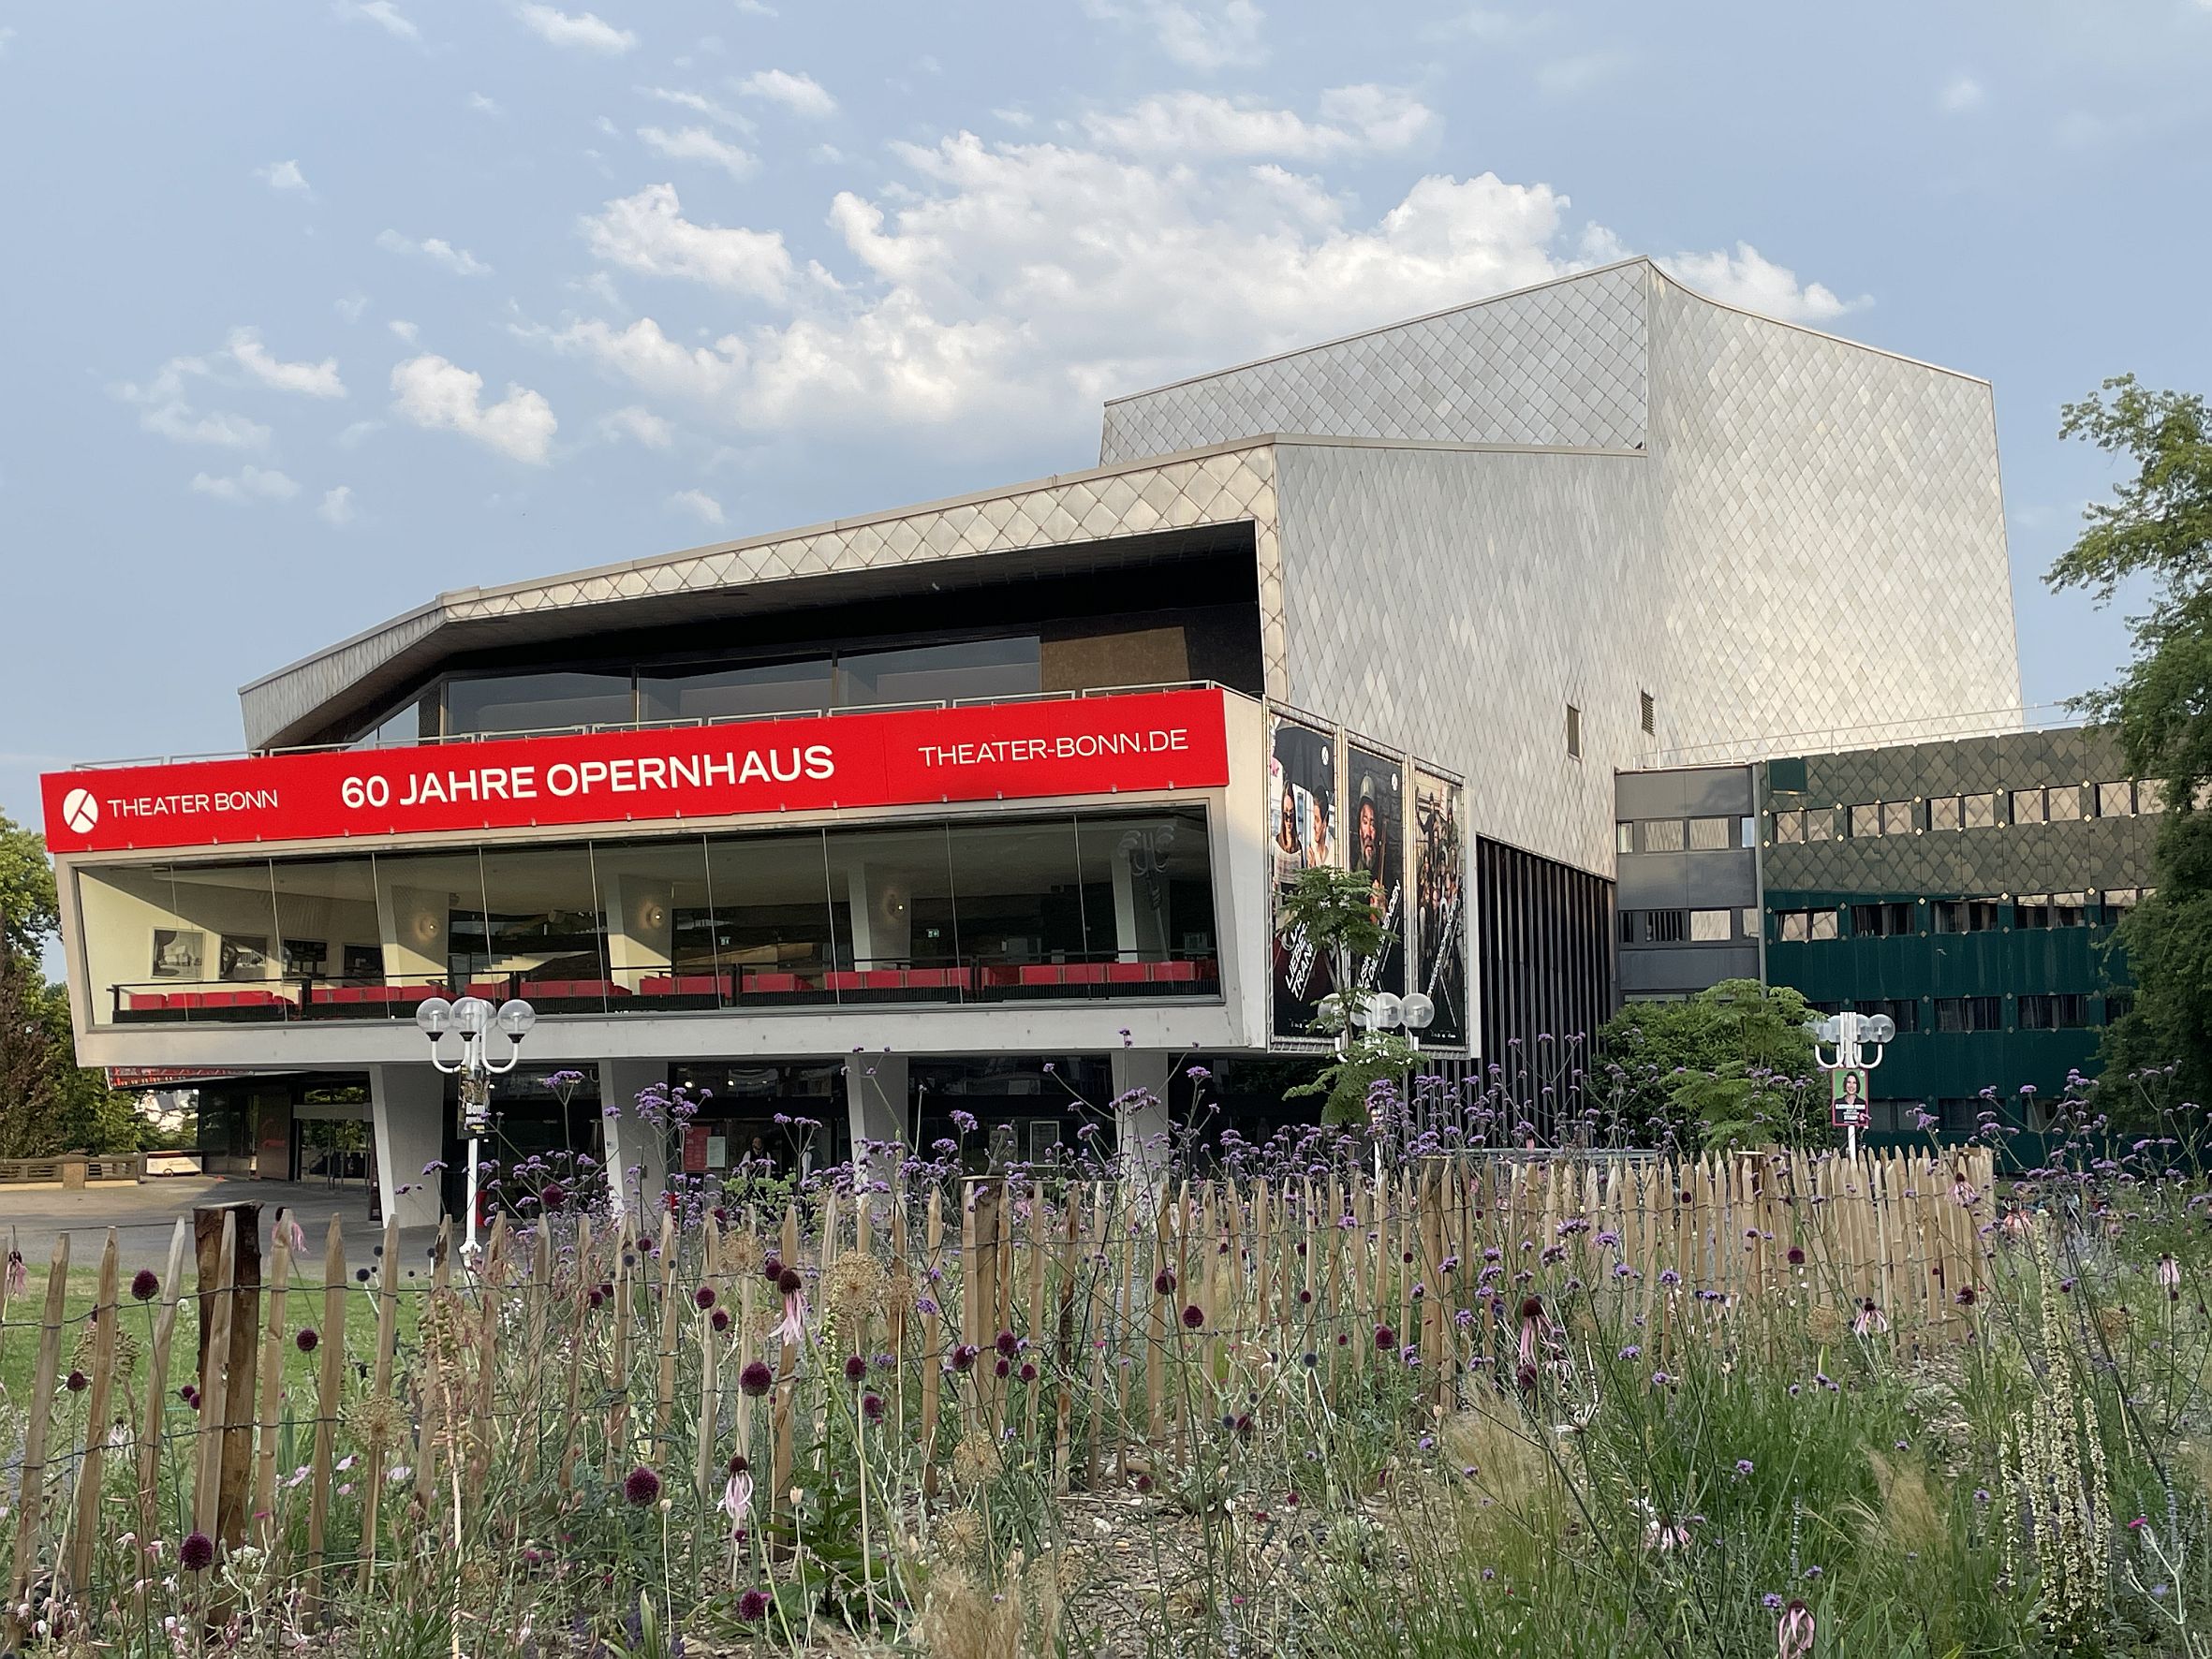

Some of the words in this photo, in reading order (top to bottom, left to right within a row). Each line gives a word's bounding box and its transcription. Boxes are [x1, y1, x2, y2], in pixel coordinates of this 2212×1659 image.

[917, 729, 1189, 768] THEATER-BONN.DE
[341, 775, 390, 809] 60
[399, 766, 538, 806] JAHRE
[546, 744, 835, 797] OPERNHAUS
[107, 794, 210, 818] THEATER
[214, 789, 278, 812] BONN
